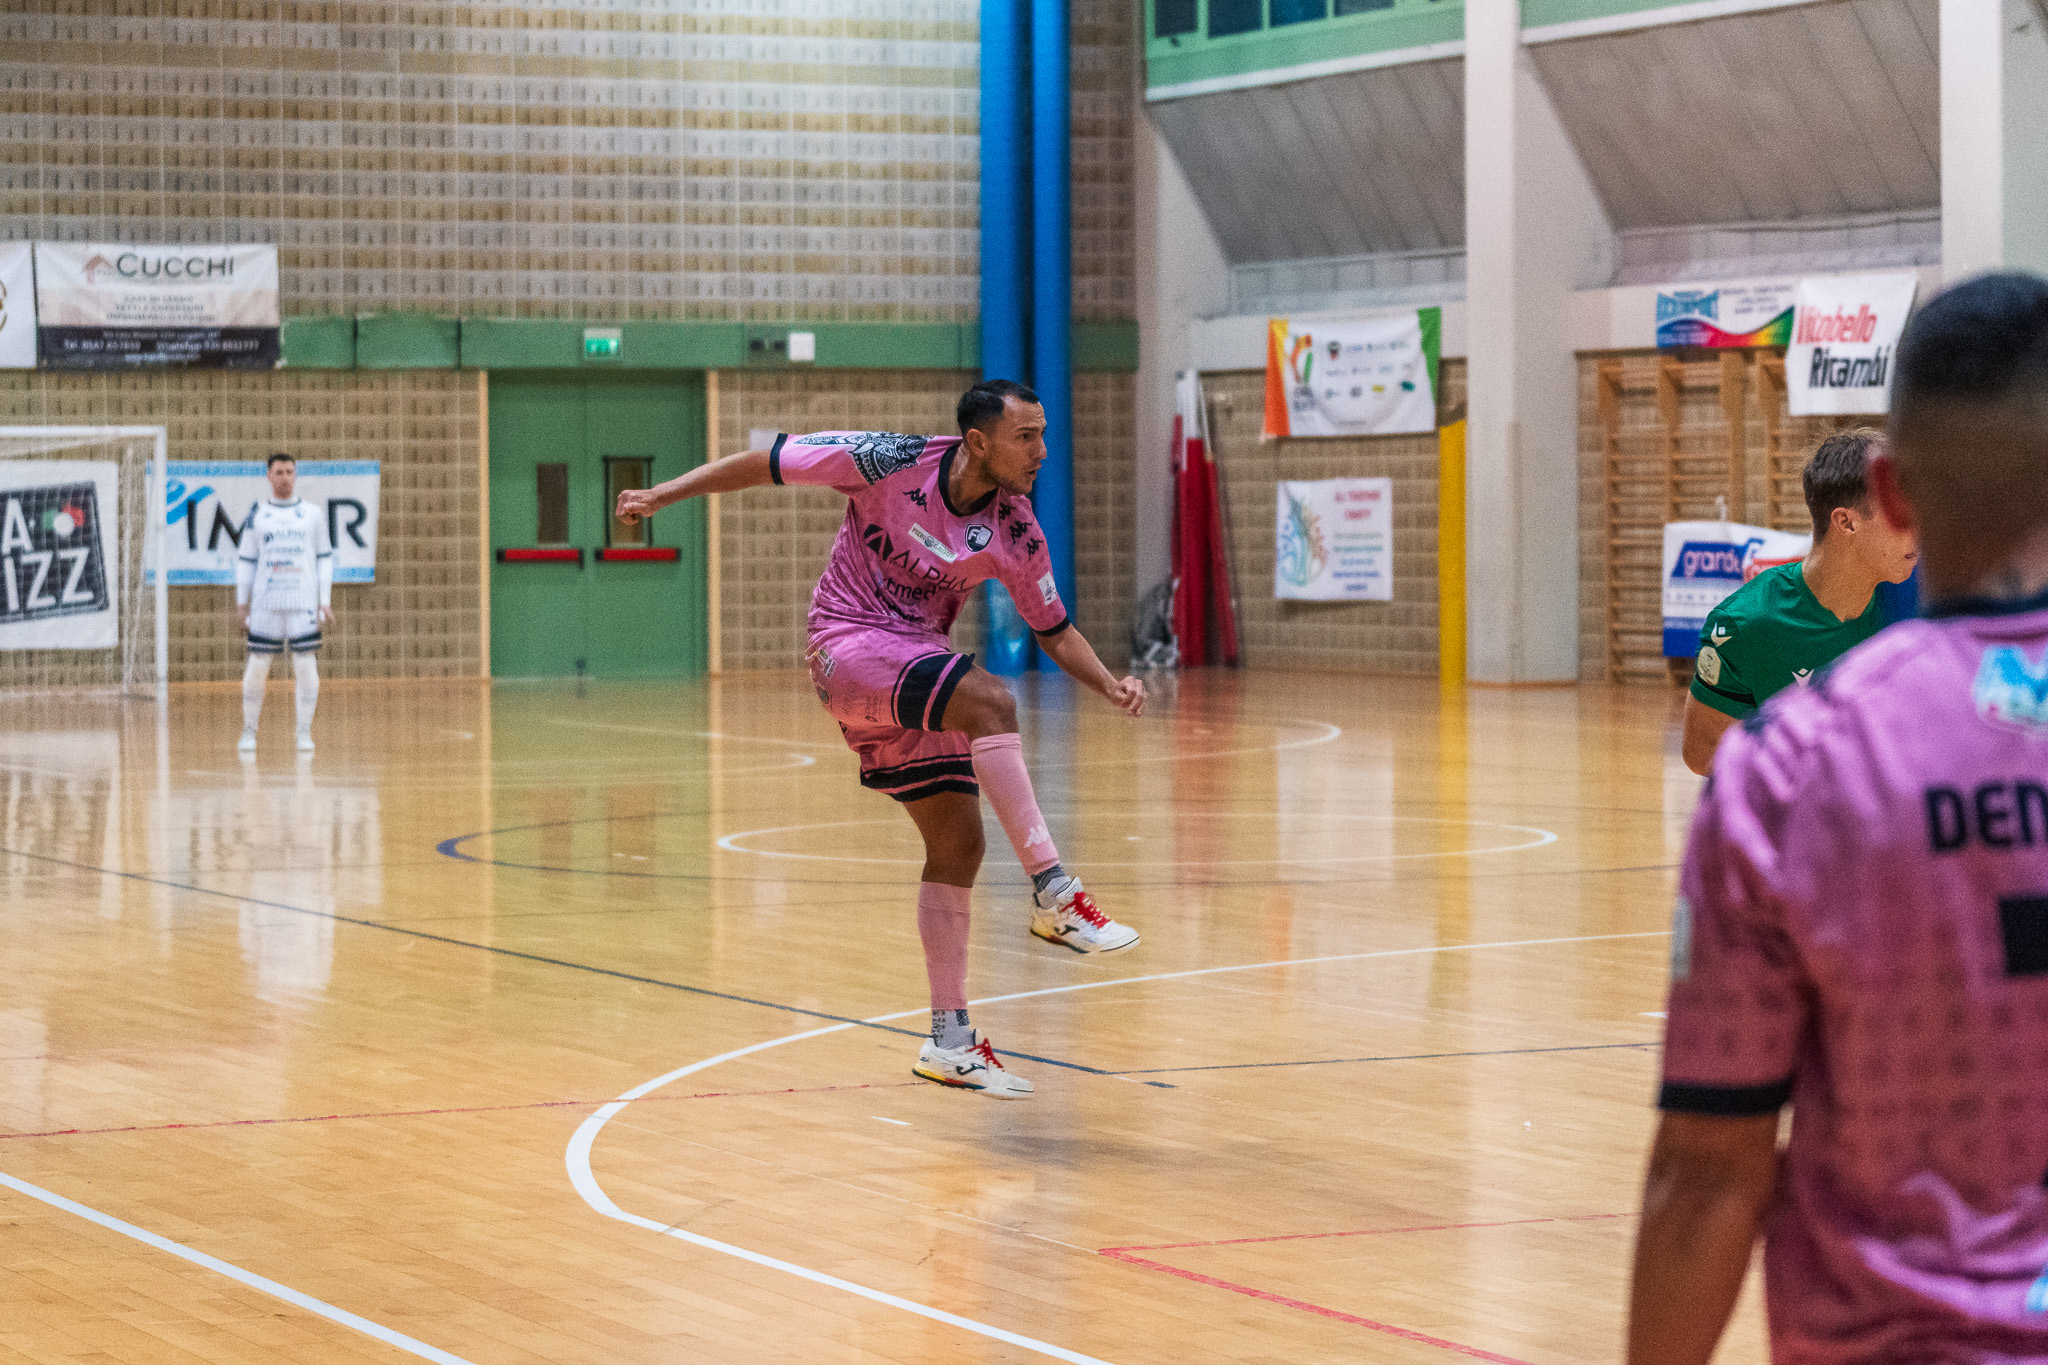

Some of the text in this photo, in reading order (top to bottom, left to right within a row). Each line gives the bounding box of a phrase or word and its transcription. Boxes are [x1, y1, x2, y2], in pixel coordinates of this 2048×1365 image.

[116, 252, 234, 278] CUCCHI
[187, 498, 367, 551] IMR
[933, 543, 956, 560] GROUP
